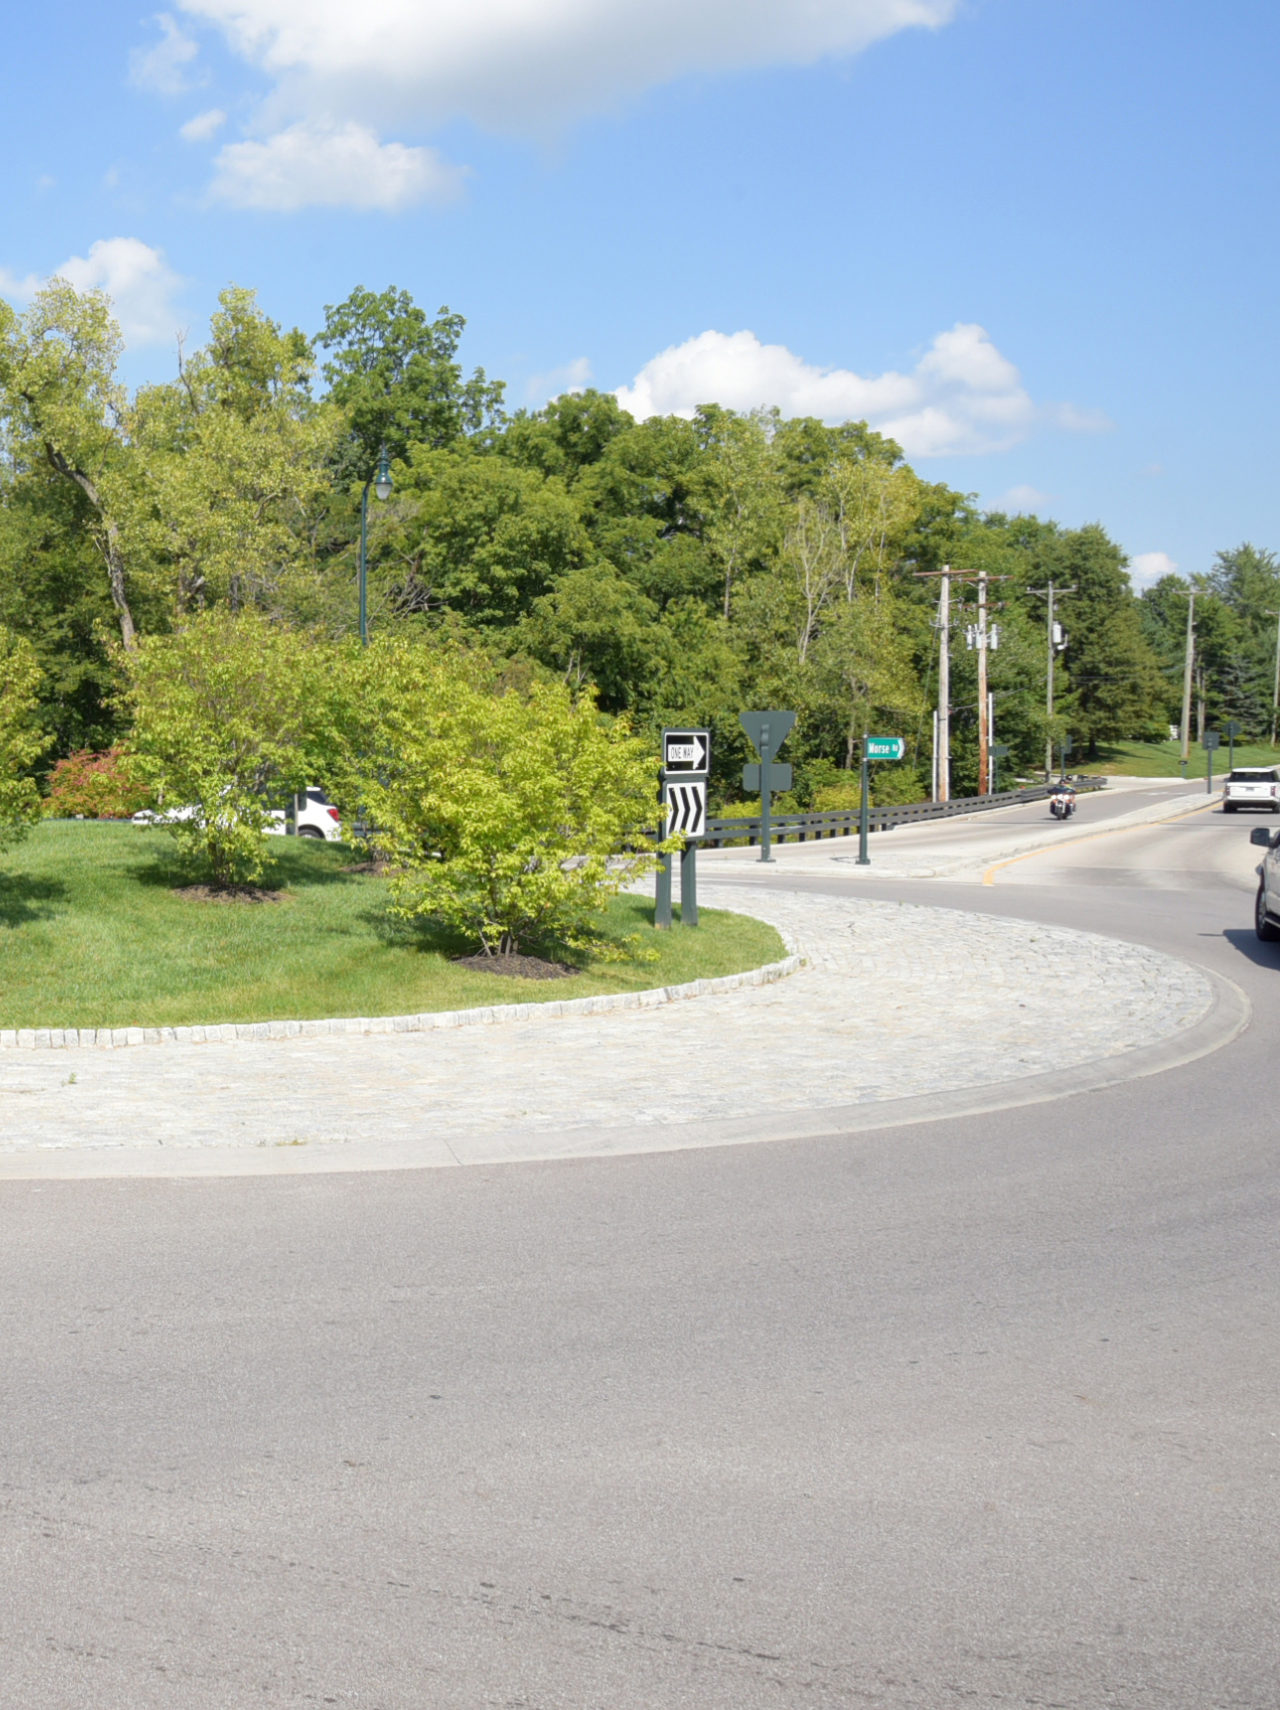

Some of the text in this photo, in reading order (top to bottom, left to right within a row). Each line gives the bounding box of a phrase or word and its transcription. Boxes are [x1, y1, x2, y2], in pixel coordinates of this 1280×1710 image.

[671, 746, 694, 759] ONE WAY
[868, 743, 890, 754] Morse
